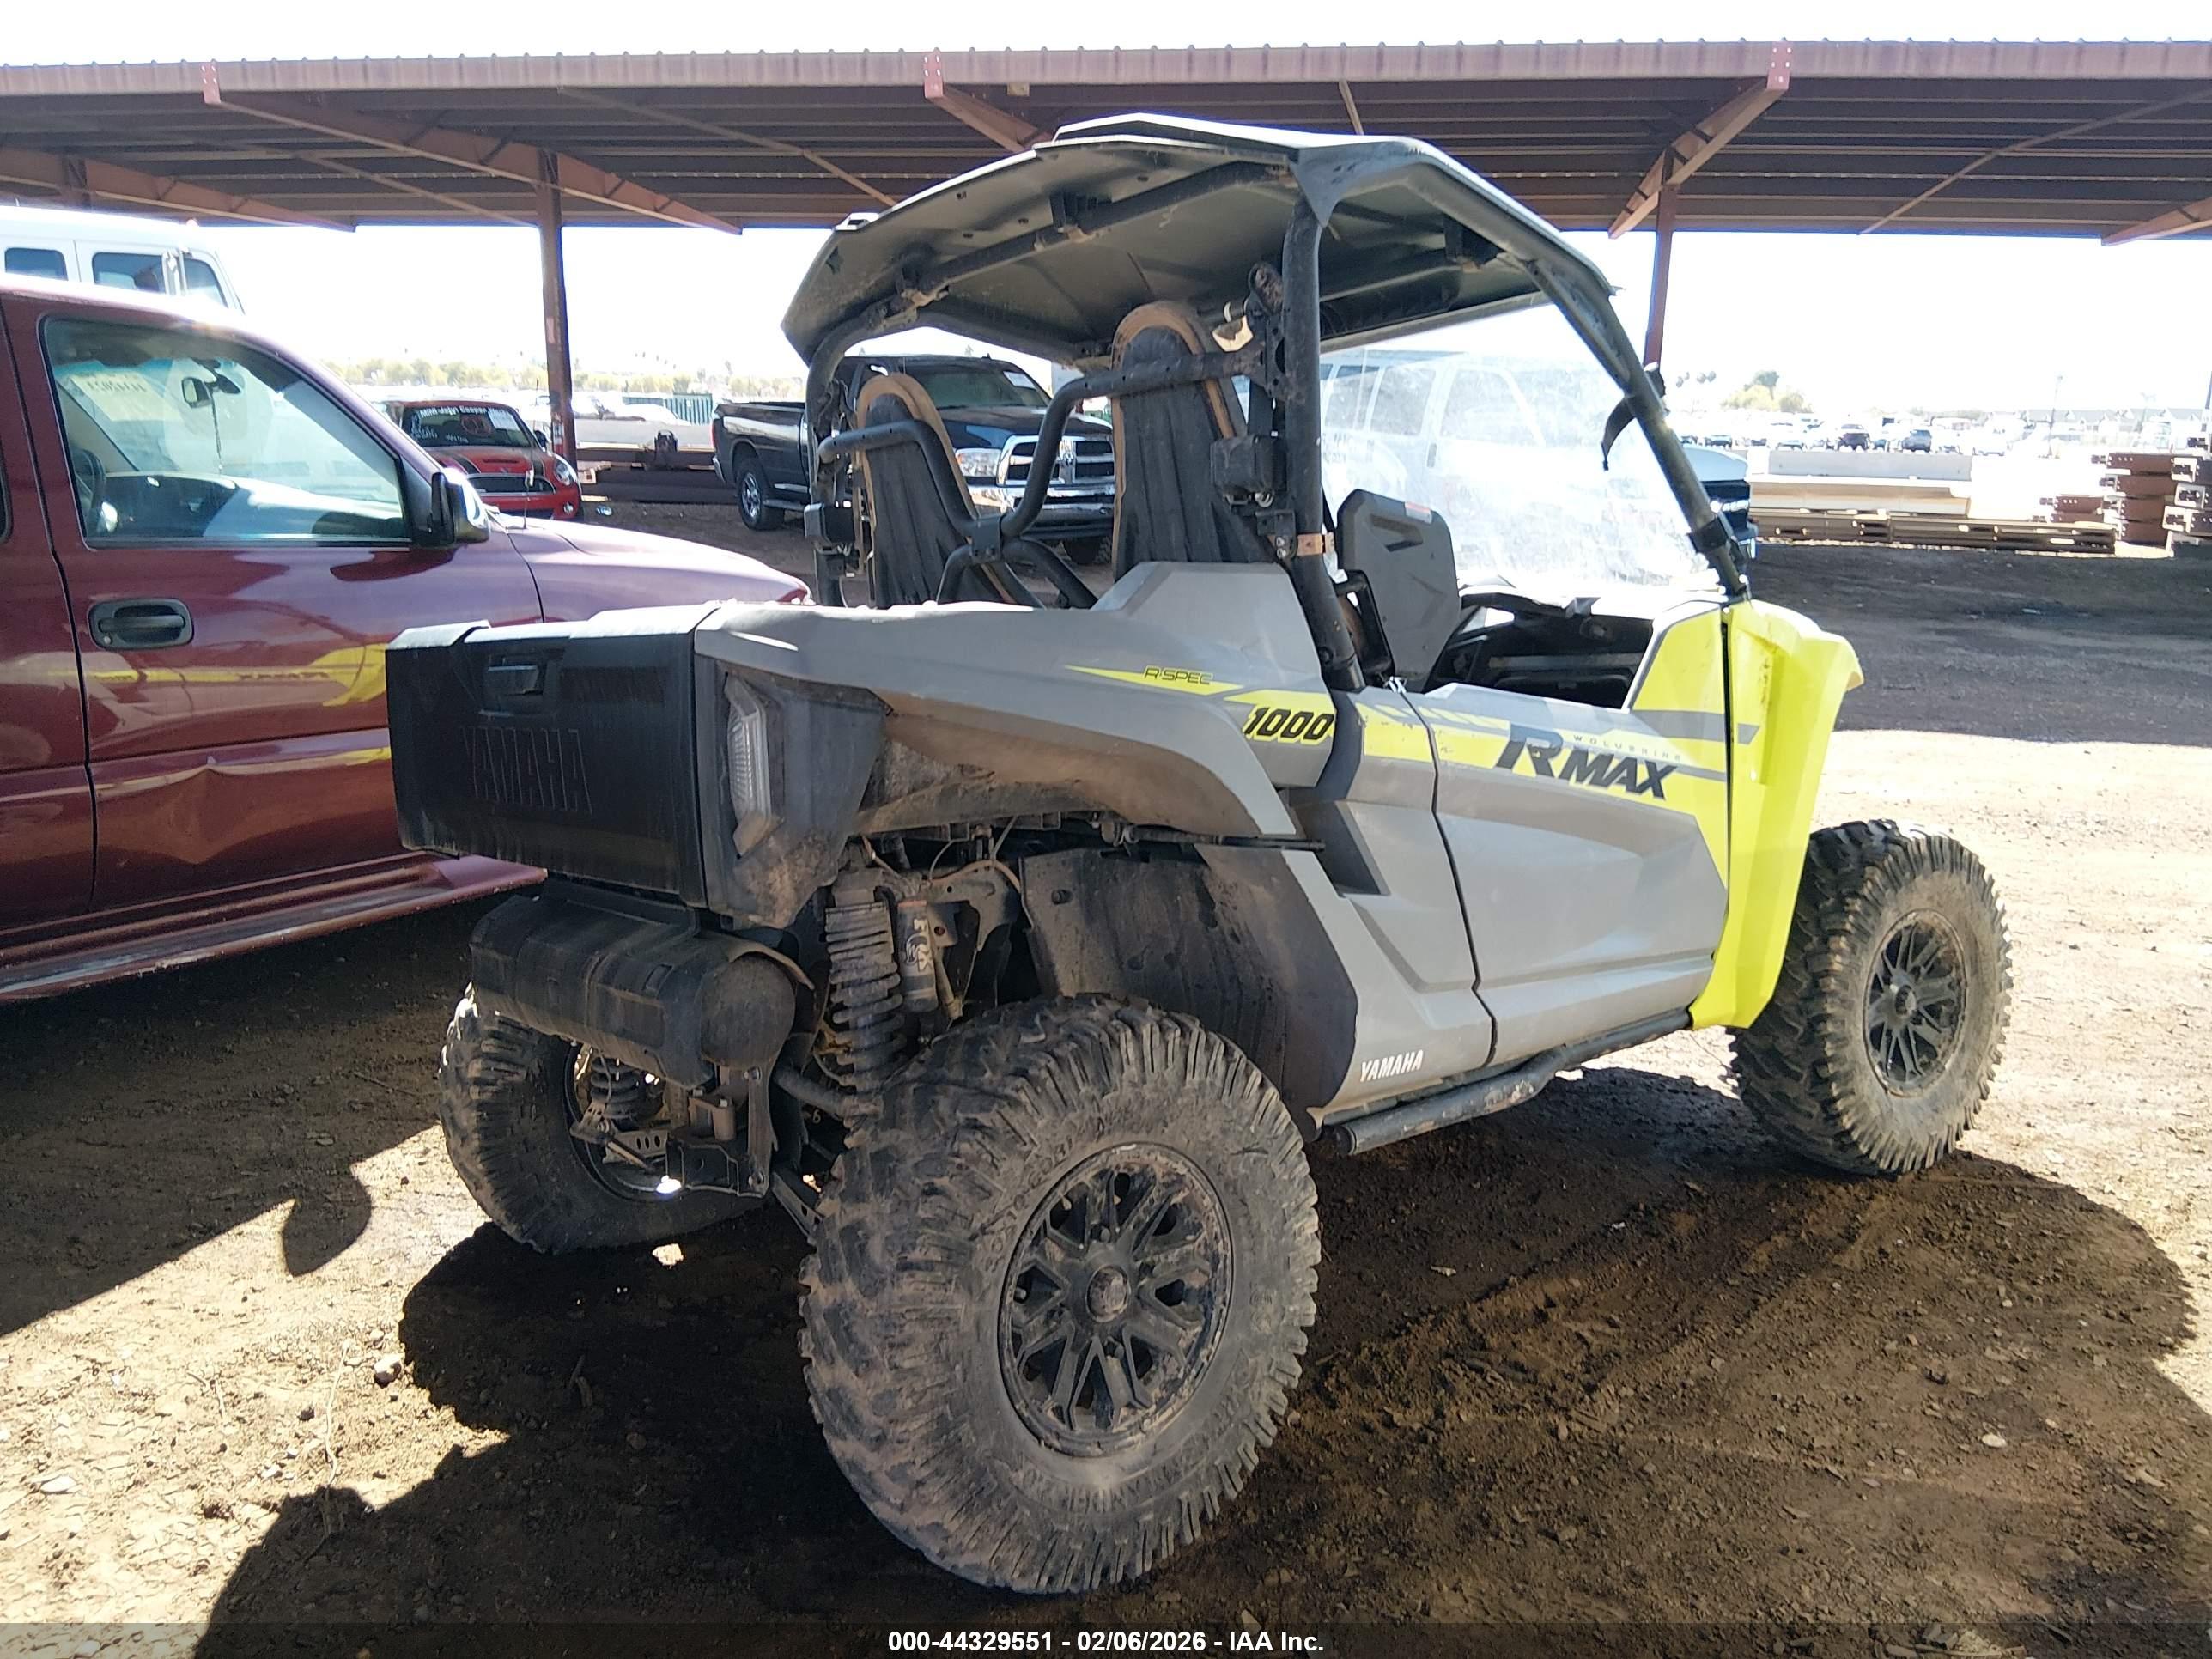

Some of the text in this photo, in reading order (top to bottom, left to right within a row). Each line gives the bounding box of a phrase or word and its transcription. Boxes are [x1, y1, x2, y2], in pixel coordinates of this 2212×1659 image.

[1244, 706, 1335, 741] 1000
[458, 725, 593, 814] YAMAHA
[1496, 724, 1677, 800] RMAX
[1360, 1049, 1424, 1082] YAMAHA
